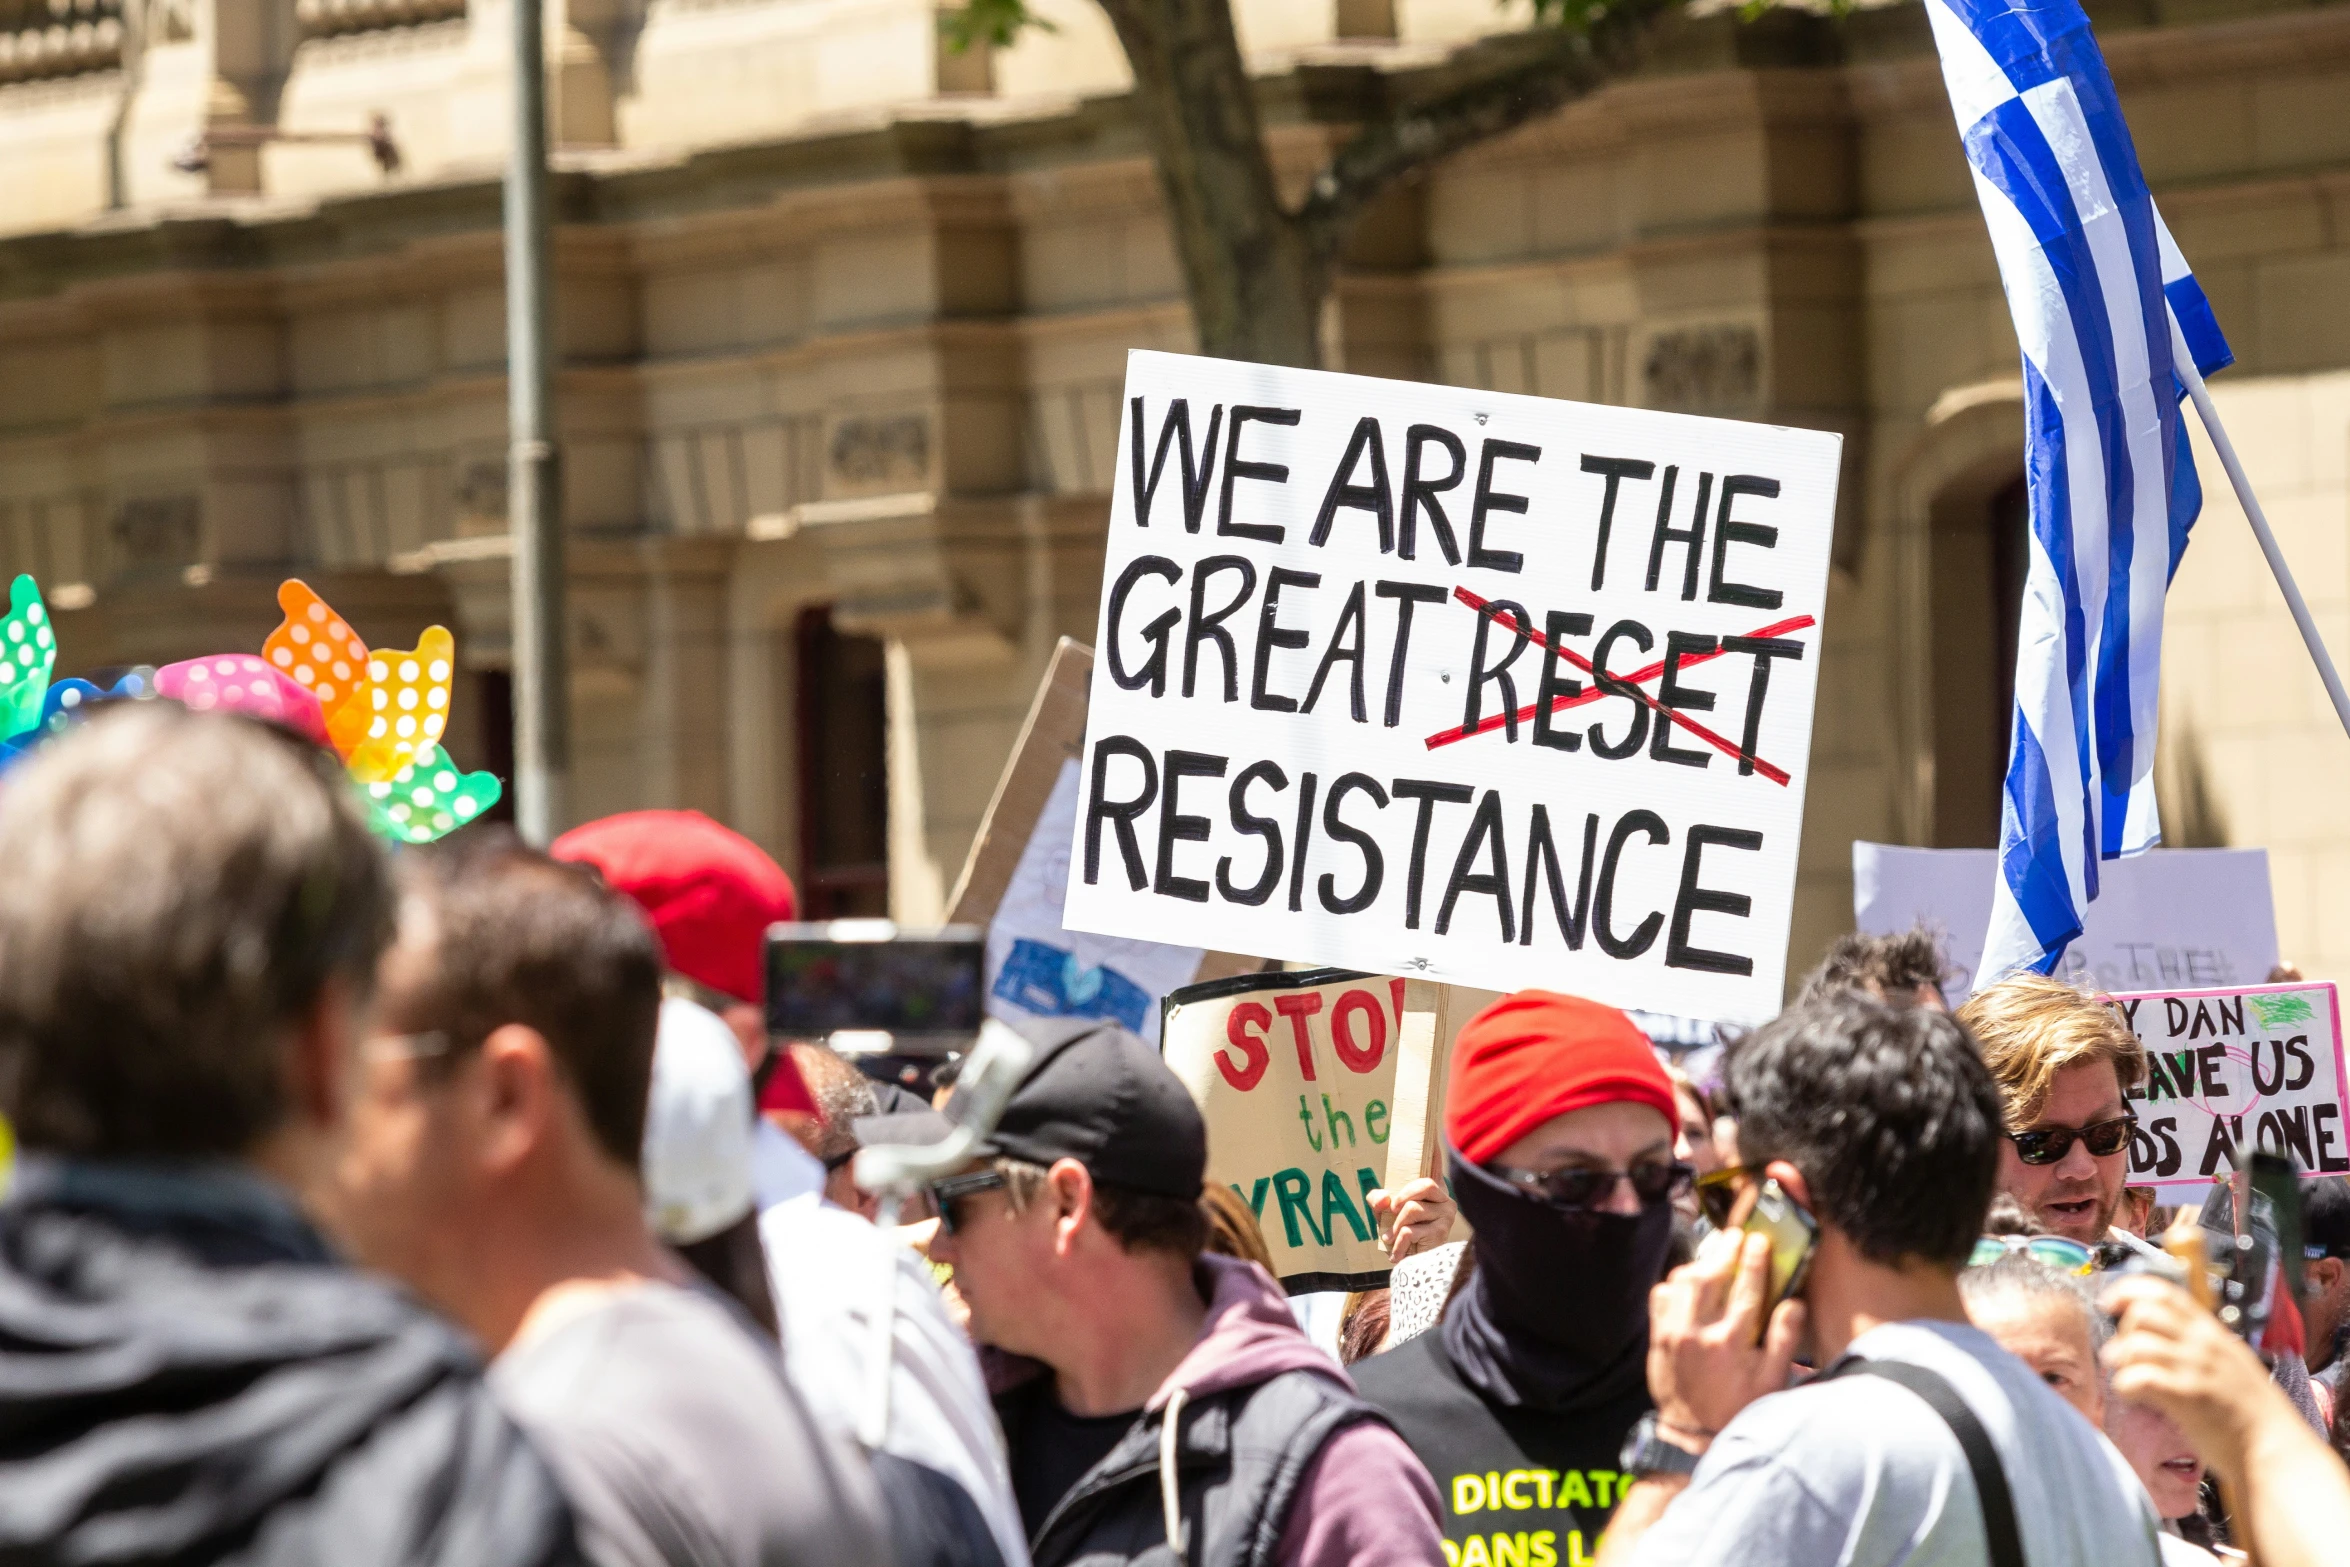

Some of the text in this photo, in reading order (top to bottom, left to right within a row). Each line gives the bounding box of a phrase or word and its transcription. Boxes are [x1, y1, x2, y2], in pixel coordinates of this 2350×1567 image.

[1131, 396, 1783, 609] WE ARE THE
[1107, 555, 1804, 775] GREAT RESET
[1083, 734, 1763, 976] RESISTANCE
[2164, 995, 2245, 1039] DAN
[2251, 1035, 2315, 1096] US
[1299, 1093, 1391, 1153] the
[2126, 1116, 2182, 1177] DS
